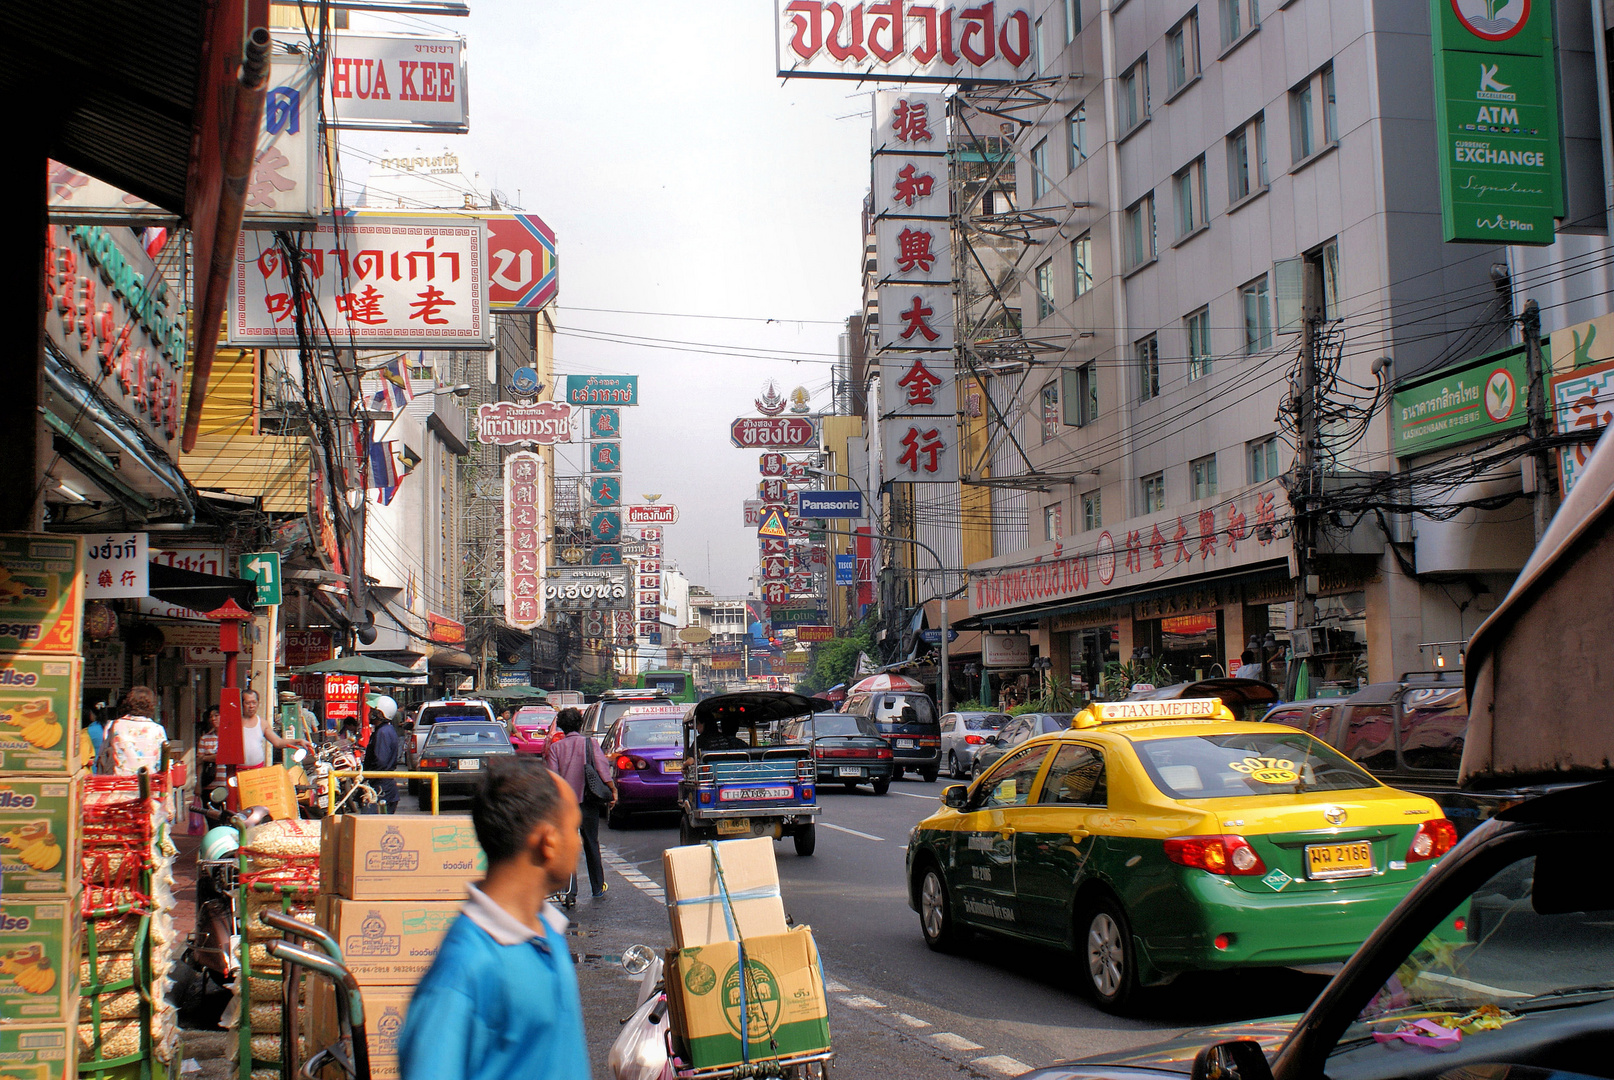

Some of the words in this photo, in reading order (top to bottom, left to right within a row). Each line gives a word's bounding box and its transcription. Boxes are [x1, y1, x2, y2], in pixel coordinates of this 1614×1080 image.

[415, 44, 454, 54] ขายยา
[333, 58, 391, 100] HUA
[399, 60, 455, 102] KEE
[1480, 63, 1512, 91] K
[1478, 92, 1515, 100] EXCELLENCE
[1476, 106, 1519, 125] ATM
[1455, 141, 1490, 149] CURRENCY
[1455, 148, 1544, 167] EXCHANGE
[1459, 175, 1544, 197] Signature
[257, 237, 460, 283] ตลาดเก่า
[892, 99, 946, 473] 振和興大金行
[1401, 381, 1480, 421] ธนาคารกสิกรไทย
[742, 419, 803, 444] ทองใบ
[1402, 419, 1448, 440] KASIKORNBANK
[597, 413, 615, 565] 龍鳳大金行
[802, 499, 860, 510] Panasonic
[786, 611, 815, 621] Lotus
[1119, 701, 1211, 718] TAXI-METER
[1228, 757, 1295, 774] 6070
[1260, 771, 1290, 780] BTC
[1336, 845, 1368, 862] 2186
[1267, 872, 1287, 883] CNG
